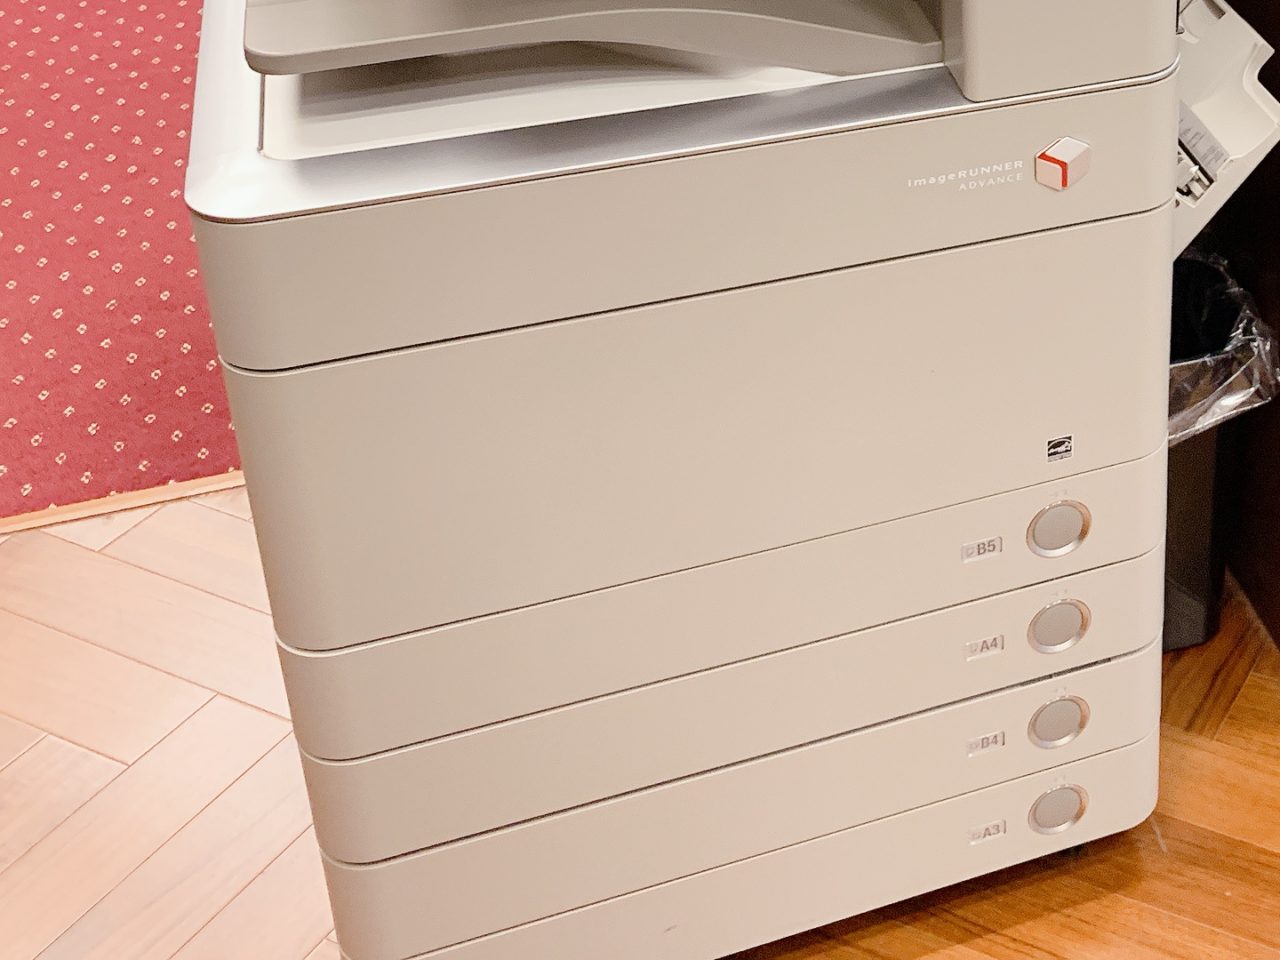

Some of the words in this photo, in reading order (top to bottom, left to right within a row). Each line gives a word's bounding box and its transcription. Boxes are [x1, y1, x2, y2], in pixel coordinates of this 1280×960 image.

[908, 160, 1024, 187] imageRUNNER
[958, 172, 1025, 192] ADVANCE
[976, 539, 997, 556] B5
[979, 637, 998, 653] A4
